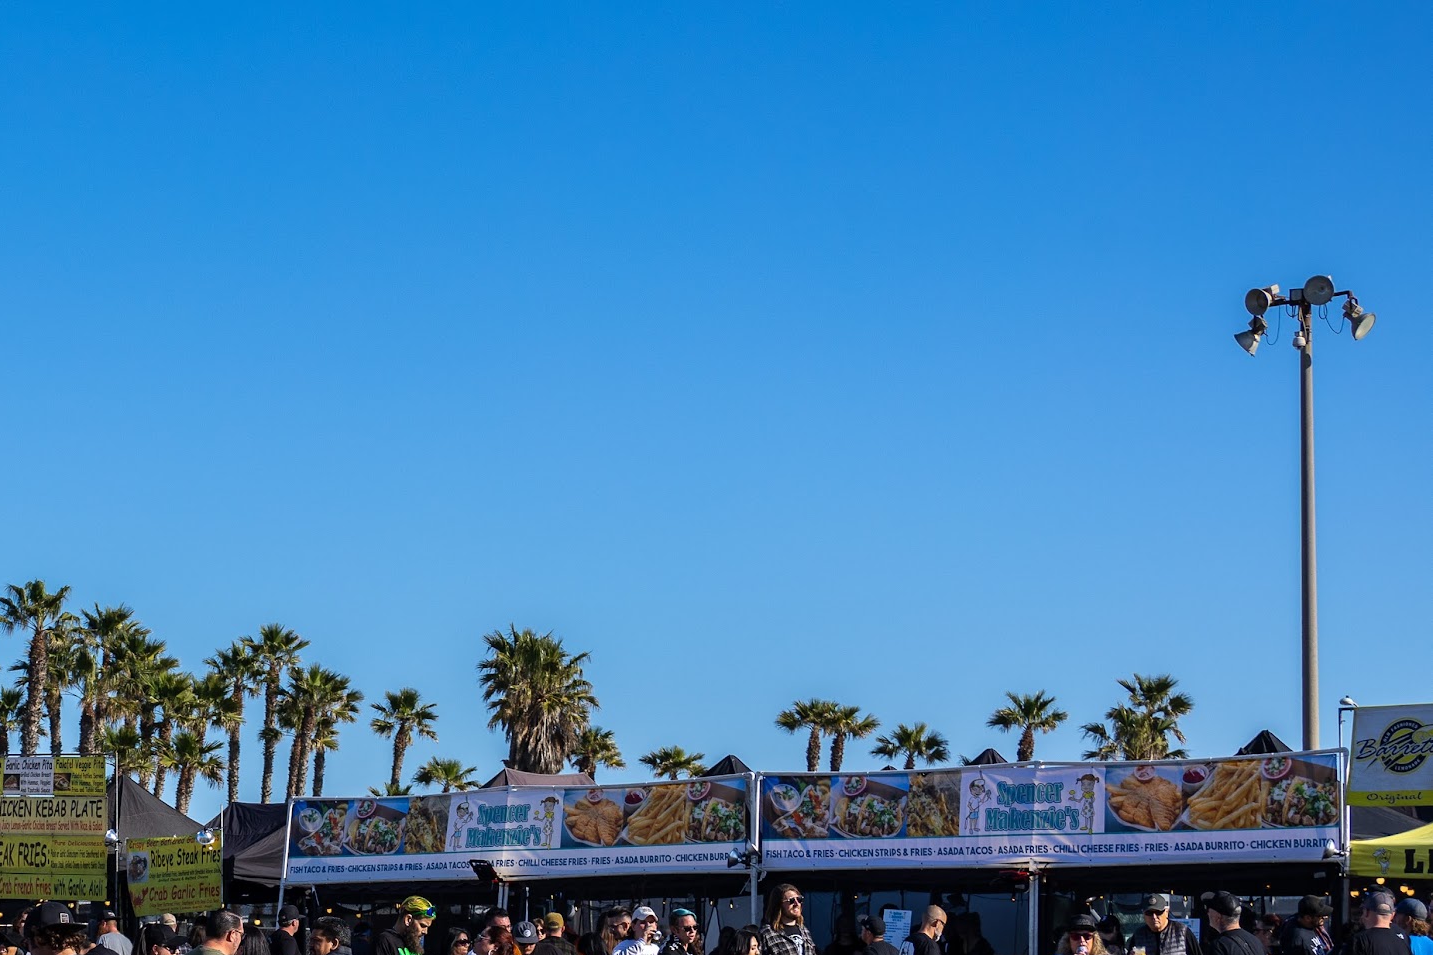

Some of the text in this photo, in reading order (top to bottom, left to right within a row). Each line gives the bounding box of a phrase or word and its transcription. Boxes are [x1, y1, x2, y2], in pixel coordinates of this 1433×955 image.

[5, 759, 53, 771] Garlic Chicken Pita
[56, 759, 104, 772] Falafel Veggie Pita
[996, 781, 1064, 807] Spencer
[1367, 791, 1422, 804] Original
[35, 800, 66, 818] KEBAB
[70, 800, 103, 818] PLATE
[477, 803, 531, 827] Spencer
[985, 806, 1080, 832] Makenzie's
[465, 825, 542, 848] Makenzie's
[18, 841, 50, 868] FRIES:
[150, 845, 221, 871] Ribeye Steak Fries
[805, 850, 812, 858] &
[813, 850, 834, 858] FRIES
[837, 849, 874, 858] CHICKEN
[874, 849, 902, 857] STRIPS
[902, 849, 909, 857] &
[910, 848, 932, 856] FRIES
[937, 847, 965, 855] ASADA
[965, 846, 993, 855] TACOS
[998, 846, 1024, 854] ASADA
[1025, 845, 1048, 854] FRIES
[1053, 845, 1079, 853] CHILLI
[1080, 844, 1114, 853] CHEESE
[1115, 843, 1139, 852] FRIES
[1144, 843, 1168, 852] FRIES
[1173, 841, 1204, 851] ASADA
[1205, 840, 1245, 850] BURRITO
[1250, 839, 1292, 849] CHICKEN
[289, 866, 304, 874] FISH
[304, 865, 321, 873] TACO
[322, 865, 327, 873] &
[327, 864, 345, 873] FRIES
[347, 864, 376, 873] CHICKEN
[377, 863, 397, 872] STRIPS
[398, 863, 404, 871] &
[405, 862, 423, 871] FRIES
[426, 861, 448, 870] ASADA
[448, 860, 470, 869] TACOS
[496, 859, 515, 867] FRIES
[518, 859, 540, 867] CHILLI
[540, 858, 567, 866] CHEESE
[568, 857, 587, 866] FRIES
[591, 856, 611, 865] FRIES
[614, 855, 638, 864] ASADA
[639, 854, 672, 864] BURRITO
[675, 853, 709, 862] CHICKEN
[1404, 848, 1433, 873] L
[14, 877, 34, 895] French
[36, 877, 52, 896] Fries
[53, 879, 66, 896] with
[68, 878, 86, 896] Garlic
[88, 879, 104, 897] Aioli
[149, 883, 220, 901] Crab Garlic Fries
